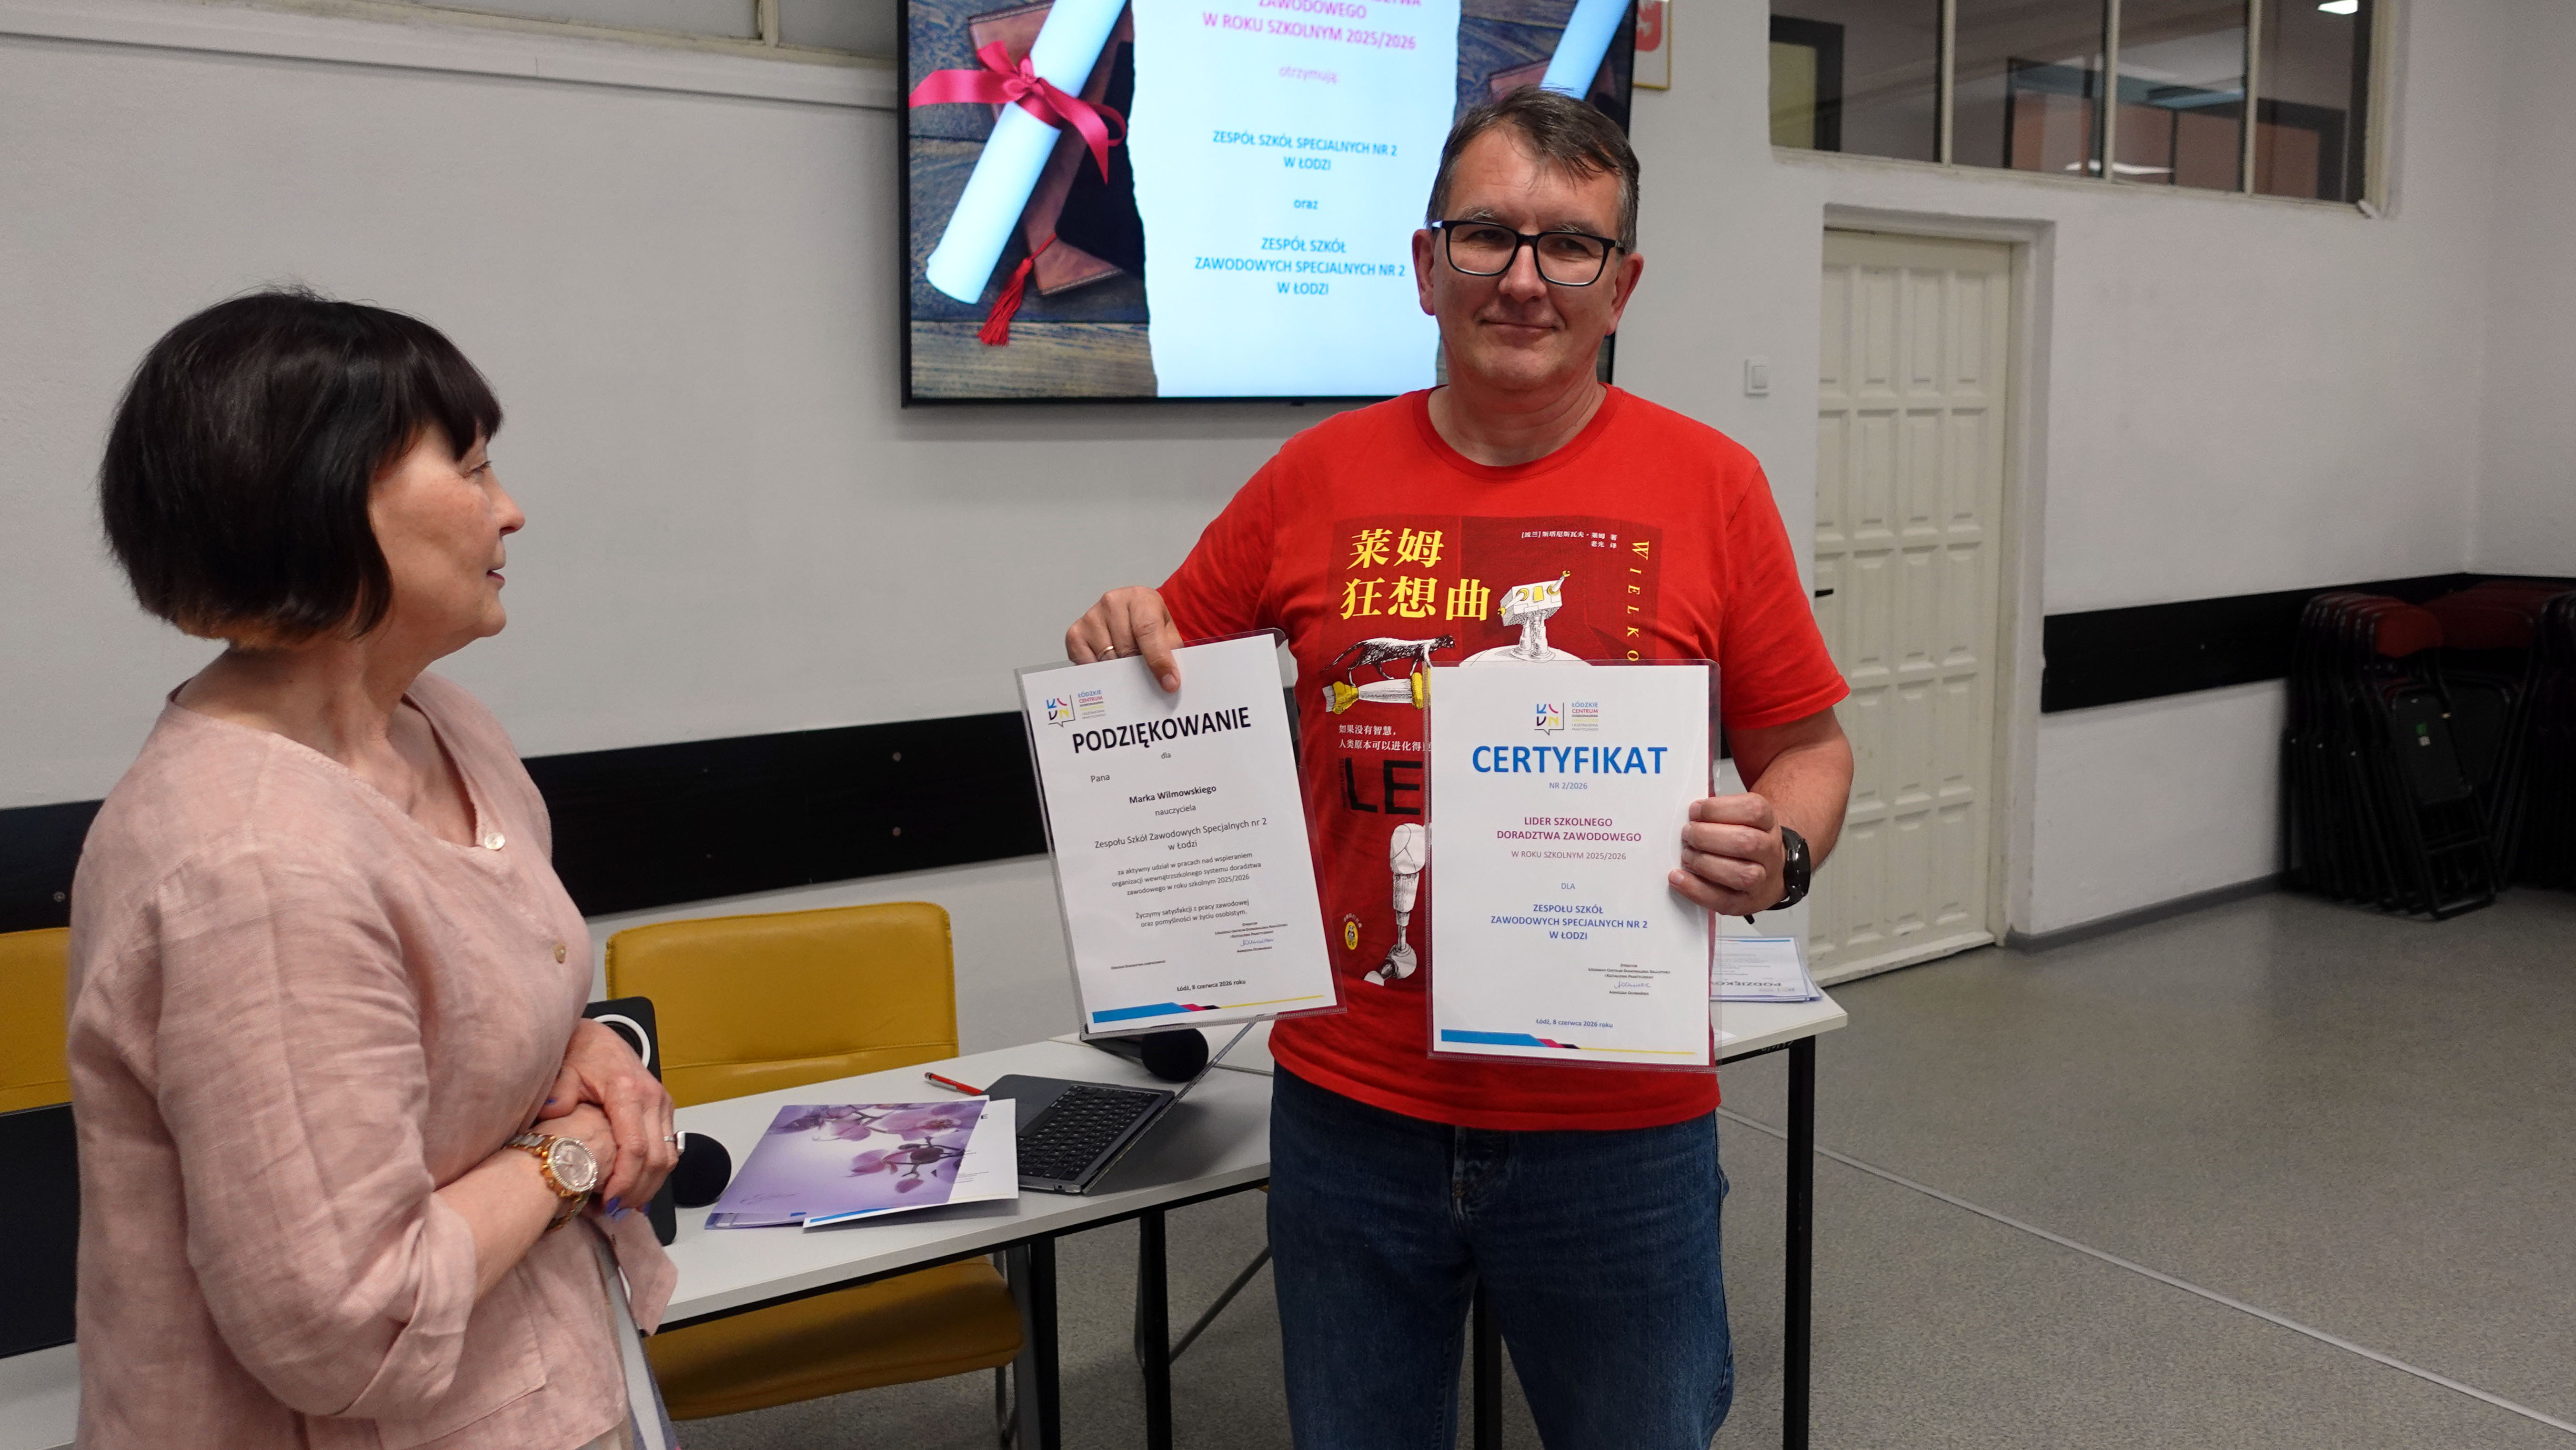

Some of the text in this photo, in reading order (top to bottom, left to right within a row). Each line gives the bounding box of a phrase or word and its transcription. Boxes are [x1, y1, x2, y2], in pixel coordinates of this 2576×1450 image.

[1203, 12, 1416, 50] W ROKU SZKOLNYM 2025/2026
[1213, 130, 1397, 156] ZESPÓŁ SZKÓŁ SPECJALNYCH NR 2
[1284, 156, 1331, 170] W ŁODZI
[1294, 199, 1319, 209] oraz
[1261, 236, 1346, 253] ZESPÓŁ SZKÓŁ
[1195, 257, 1405, 277] ZAWODOWYCH SPECJALNYCH NR 2
[1277, 282, 1329, 295] W ŁODZI
[1346, 528, 1444, 570] 莱姆
[1340, 576, 1491, 621] 狂想曲
[1072, 707, 1252, 753] PODZIĘKOWANIE
[1472, 746, 1667, 774] CERTYFIKAT
[1091, 774, 1110, 783] Pana
[1129, 786, 1216, 804] Marka Wilmowskiego
[1155, 804, 1196, 816] nauczyciela
[1524, 817, 1613, 827] LIDER SZKOLNEGO
[1094, 838, 1125, 849] Zespołu
[1127, 835, 1148, 844] Szkół
[1149, 827, 1201, 841] Zawodowych
[1203, 820, 1249, 834] Specjalnych
[1497, 830, 1642, 841] DORADZTWA ZAWODOWEGO
[1177, 840, 1198, 850] Łodzi
[1125, 866, 1150, 874] aktywny
[1152, 862, 1169, 871] udział
[1177, 859, 1201, 868] pracach
[1214, 852, 1253, 863] wspieraniem
[1586, 852, 1626, 861] 2025/2026
[1112, 877, 1143, 887] organizacji
[1144, 869, 1203, 883] wewnątrzszkolnego
[1230, 862, 1262, 871] doradztwa
[1127, 885, 1165, 895] zawodowego
[1189, 879, 1216, 888] szkolnym
[1217, 873, 1250, 884] 2025/2026
[1162, 906, 1192, 916] satysfakcji
[1216, 899, 1250, 909] zawodowej
[1533, 904, 1604, 914] ZESPOŁU SZKÓŁ
[1155, 916, 1191, 926] pomyślności
[1215, 909, 1248, 918] osobistym.
[1491, 915, 1559, 925] ZAWODOWYCH
[1562, 918, 1624, 928] SPECJALNYCH
[1561, 931, 1587, 940] ŁODZI
